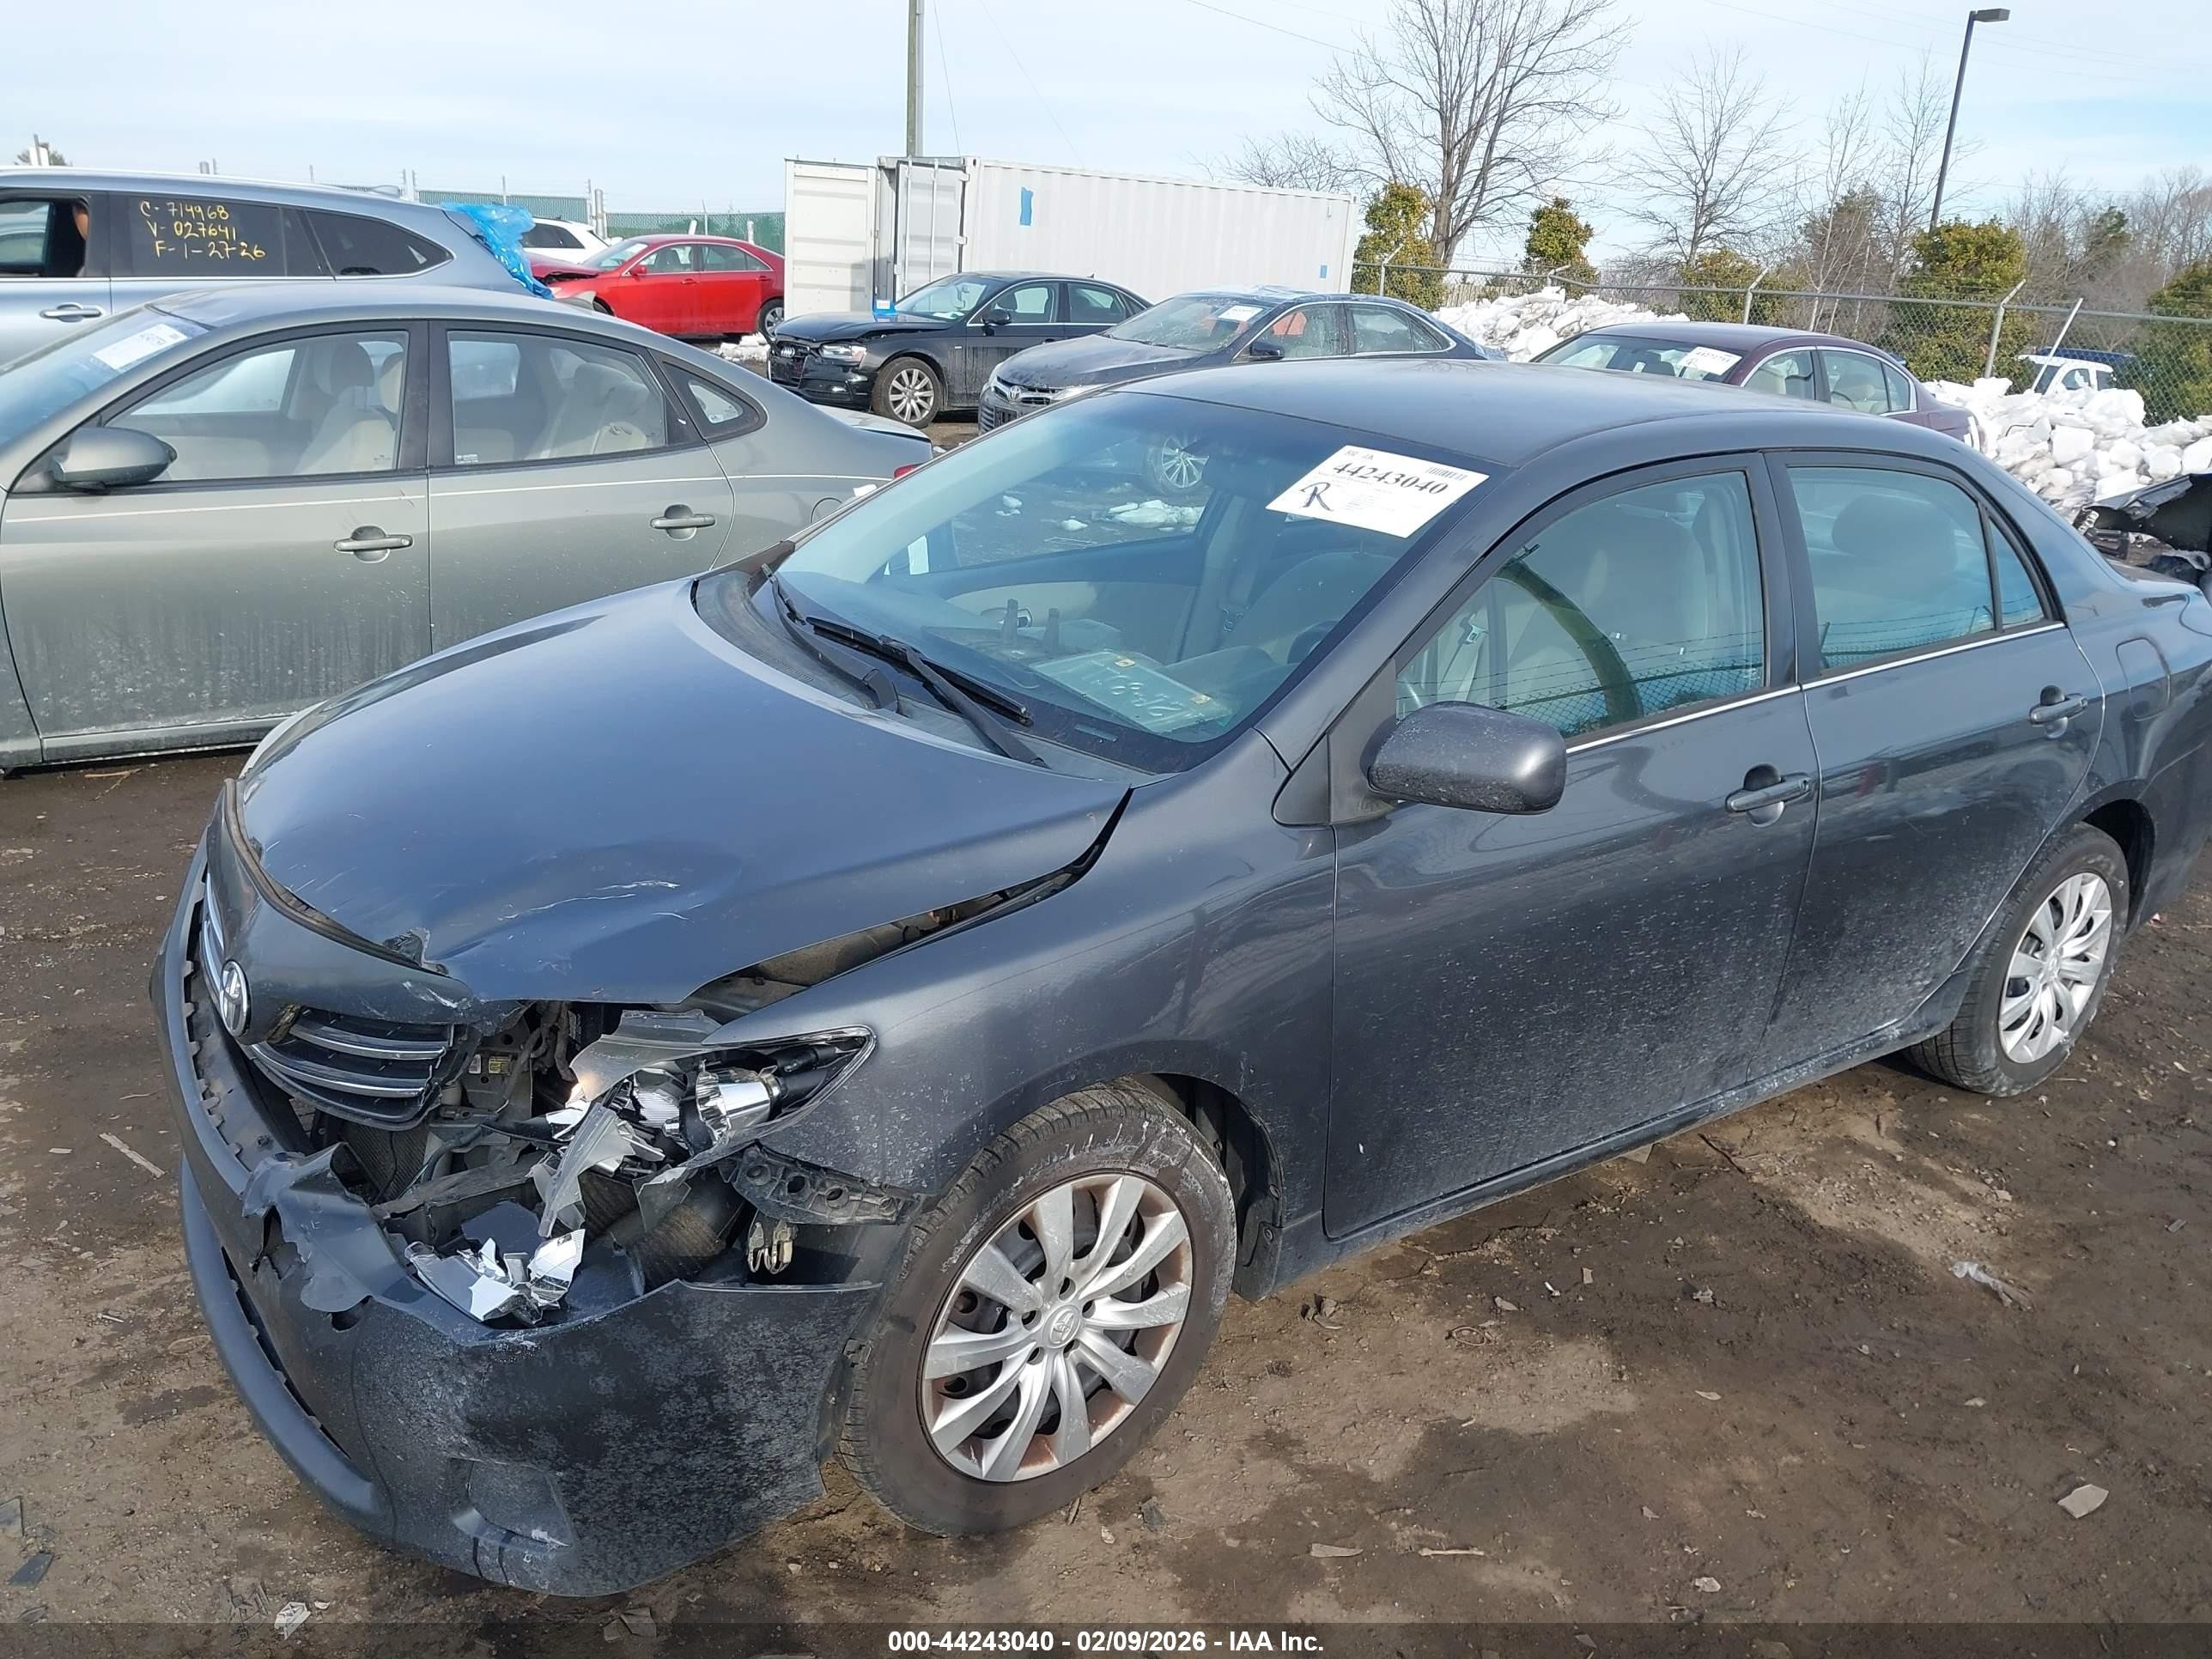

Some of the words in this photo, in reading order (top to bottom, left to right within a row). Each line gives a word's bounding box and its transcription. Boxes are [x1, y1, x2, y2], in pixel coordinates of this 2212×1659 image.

[167, 202, 229, 221] 714968
[174, 221, 236, 240] 027641
[1334, 462, 1449, 494] 44243040
[1299, 482, 1333, 512] R
